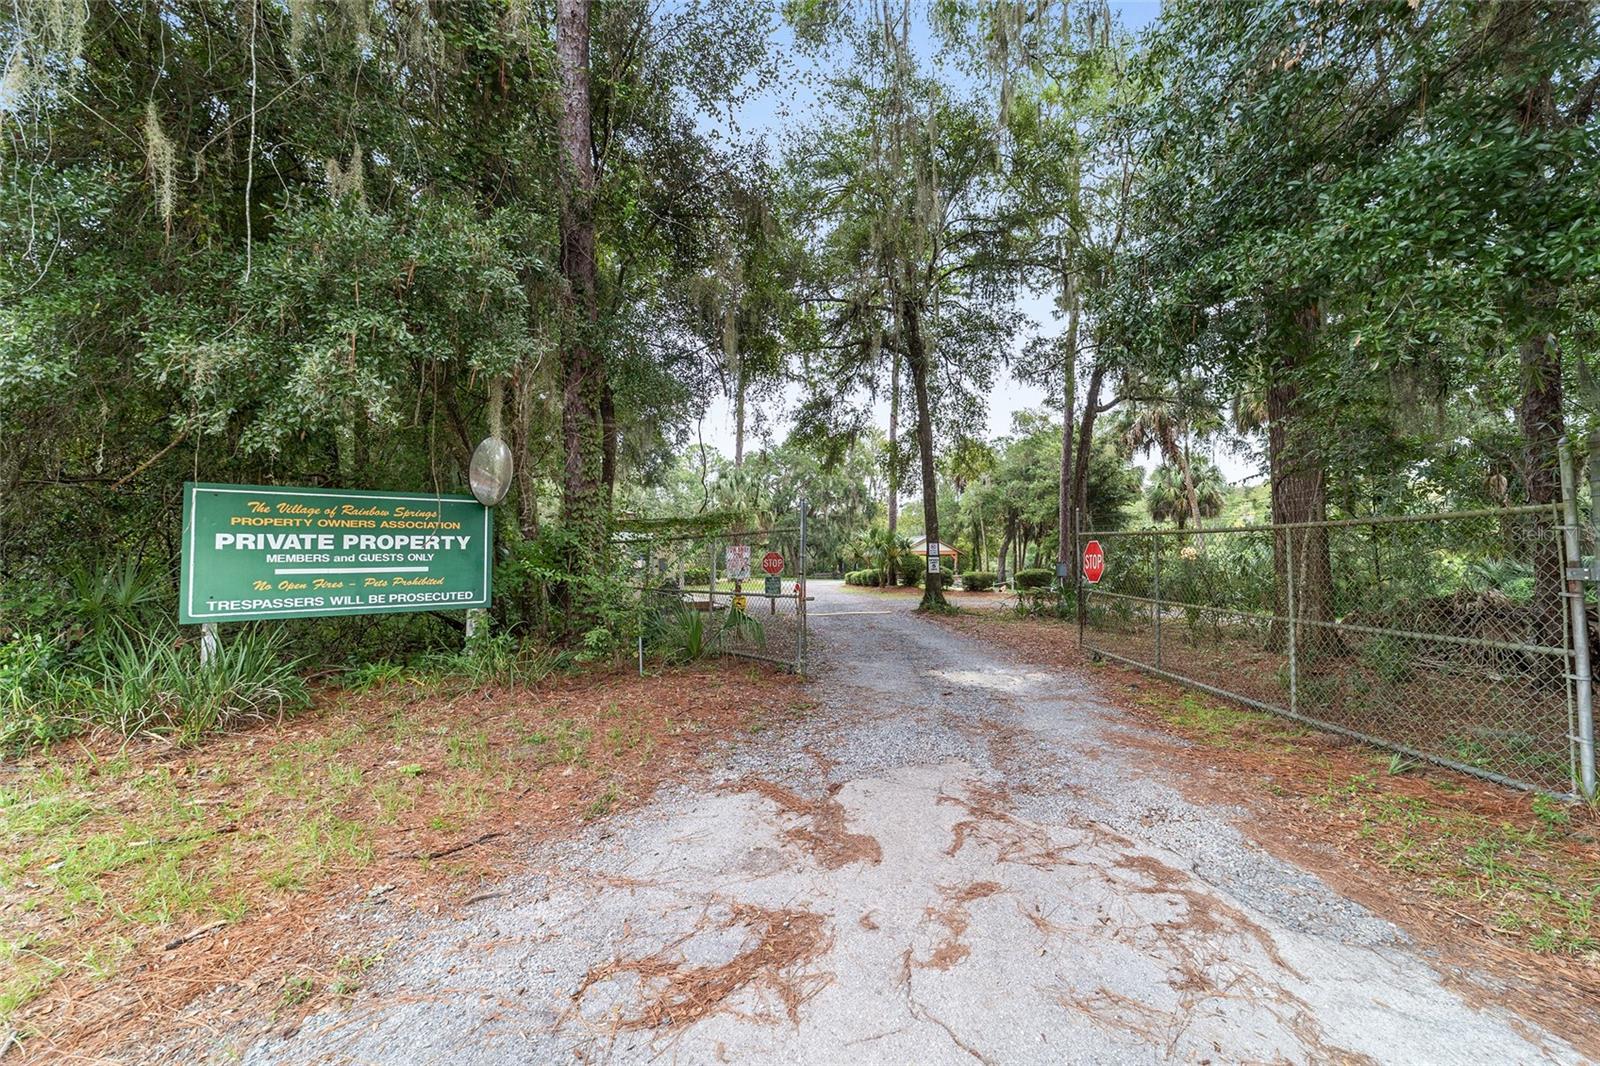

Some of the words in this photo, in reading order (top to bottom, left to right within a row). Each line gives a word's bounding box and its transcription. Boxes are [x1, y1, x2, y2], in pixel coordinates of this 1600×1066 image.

[247, 501, 270, 513] The
[276, 502, 321, 518] Village
[324, 505, 338, 518] of
[341, 504, 390, 517] Rainbow
[393, 506, 438, 520] Springs
[231, 517, 313, 527] PROPERTY
[317, 519, 376, 528] OWNERS
[380, 520, 461, 530] ASSOCIATION
[215, 533, 335, 550] PRIVATE
[343, 534, 471, 550] PROPERTY
[266, 553, 330, 563] MEMBERS
[333, 553, 355, 562] and
[358, 553, 404, 562] GUESTS
[407, 553, 434, 562] ONLY
[763, 558, 783, 568] STOP
[1085, 554, 1102, 569] STOP
[252, 580, 272, 591] No
[277, 580, 307, 592] Open
[312, 578, 344, 590] Fires
[364, 577, 388, 588] Pets
[392, 576, 445, 587] Prohibited
[206, 597, 324, 611] TRESPASSERS
[330, 595, 364, 605] WILL
[368, 594, 386, 604] BE
[389, 591, 473, 603] PROSECUTED
